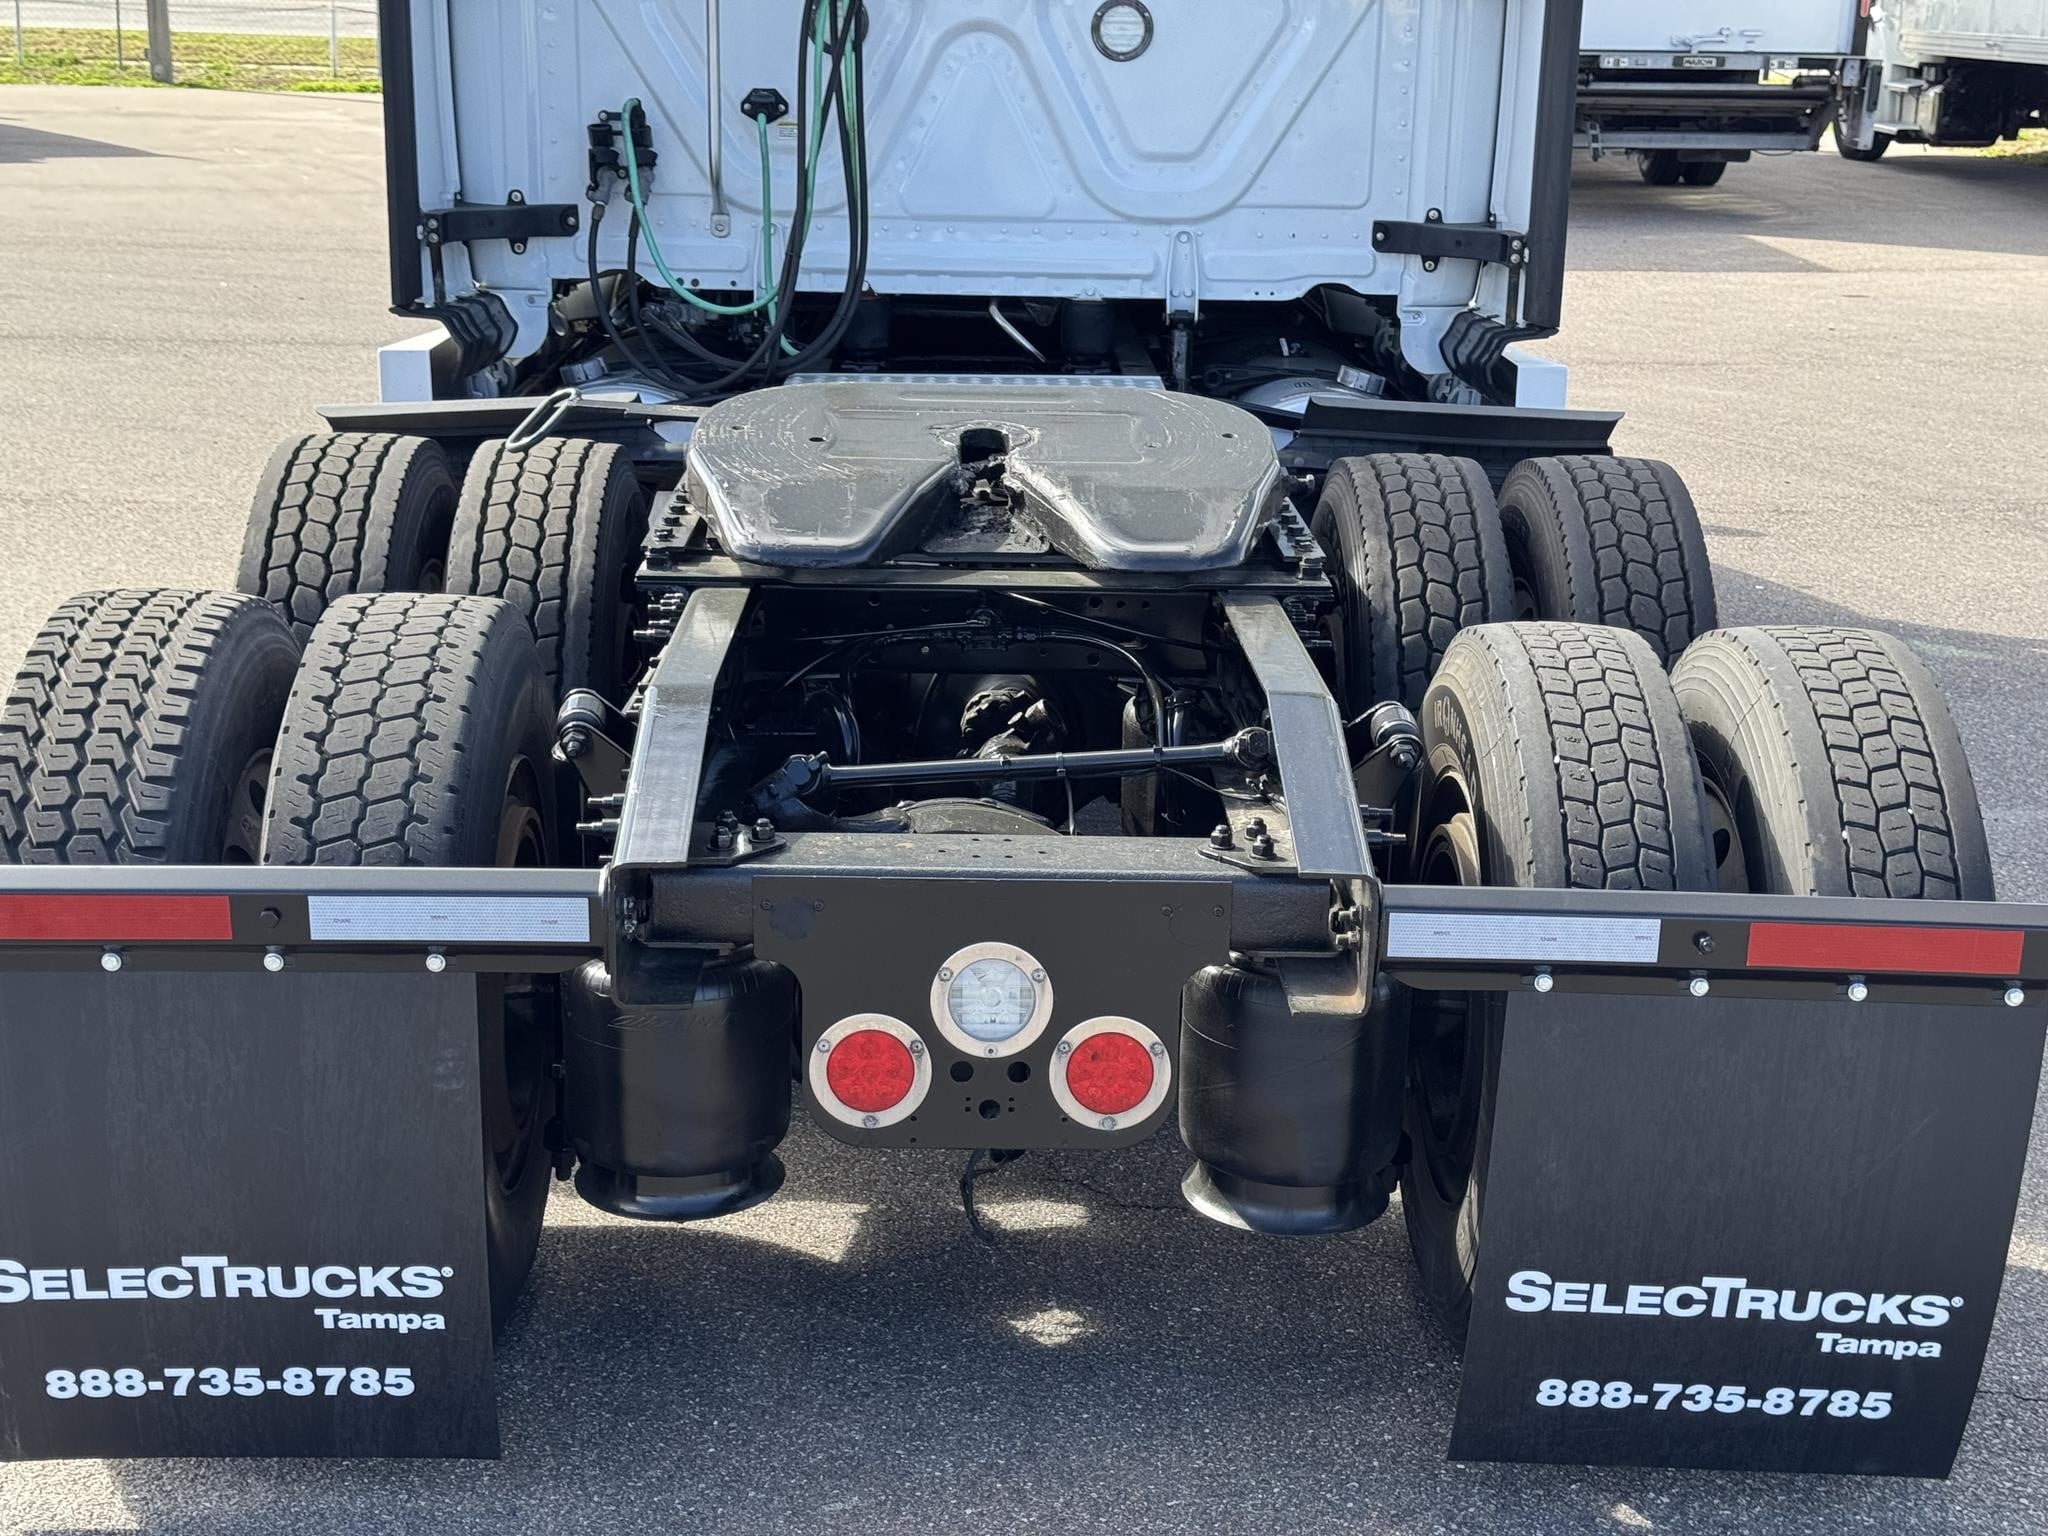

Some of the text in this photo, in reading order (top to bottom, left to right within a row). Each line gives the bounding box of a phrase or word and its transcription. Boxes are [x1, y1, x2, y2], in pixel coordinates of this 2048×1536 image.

[314, 1309, 445, 1333] Tampa
[1816, 1333, 1941, 1360] Tampa
[46, 1367, 414, 1398] 888-735-8785
[1536, 1379, 1892, 1419] 888-735-8785
